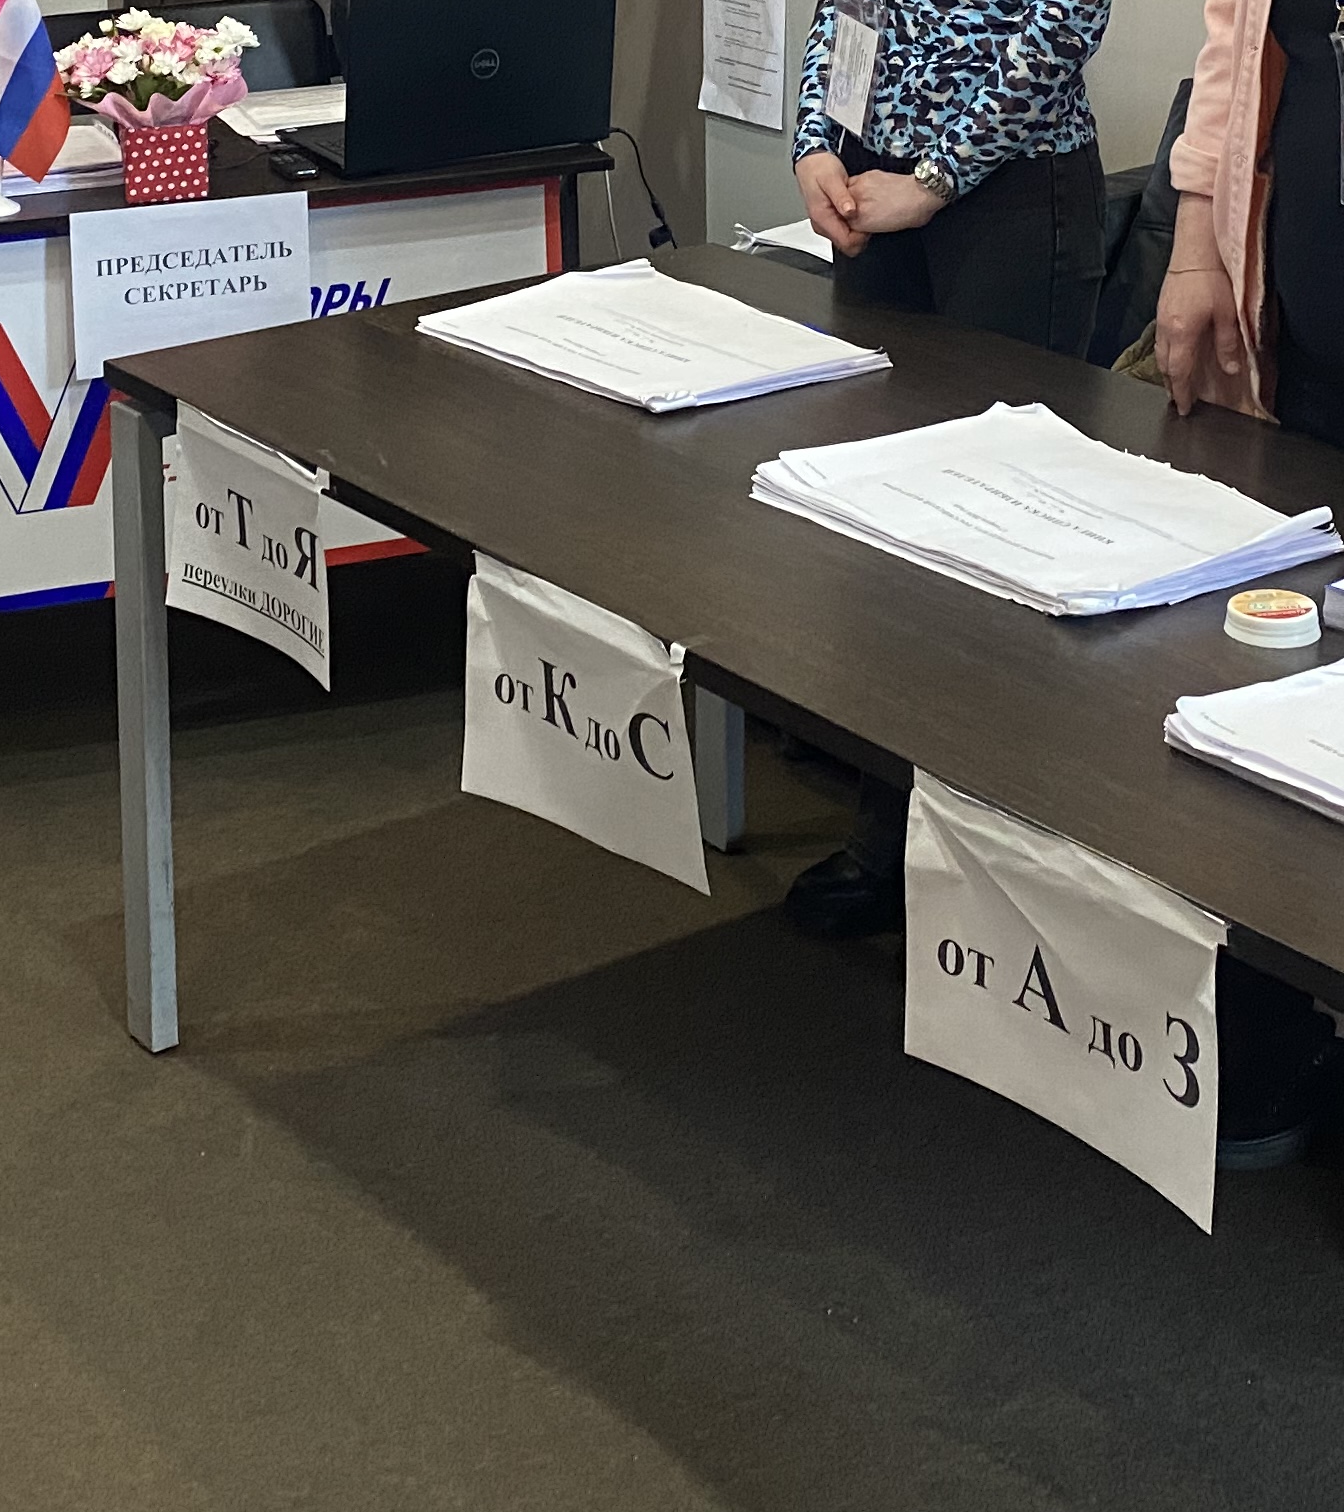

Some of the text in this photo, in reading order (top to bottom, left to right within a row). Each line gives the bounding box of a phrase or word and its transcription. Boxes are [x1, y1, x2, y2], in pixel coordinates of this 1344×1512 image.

[96, 240, 293, 277] ПРЕДСЕДАТЕЛЬ
[124, 275, 268, 305] СЕКРЕТАРЬ
[195, 488, 320, 593] от Т до Я
[184, 562, 257, 606] переулки
[494, 657, 675, 782] от К до С
[937, 938, 995, 989] от
[1011, 944, 1071, 1034] А
[1087, 1015, 1143, 1073] до
